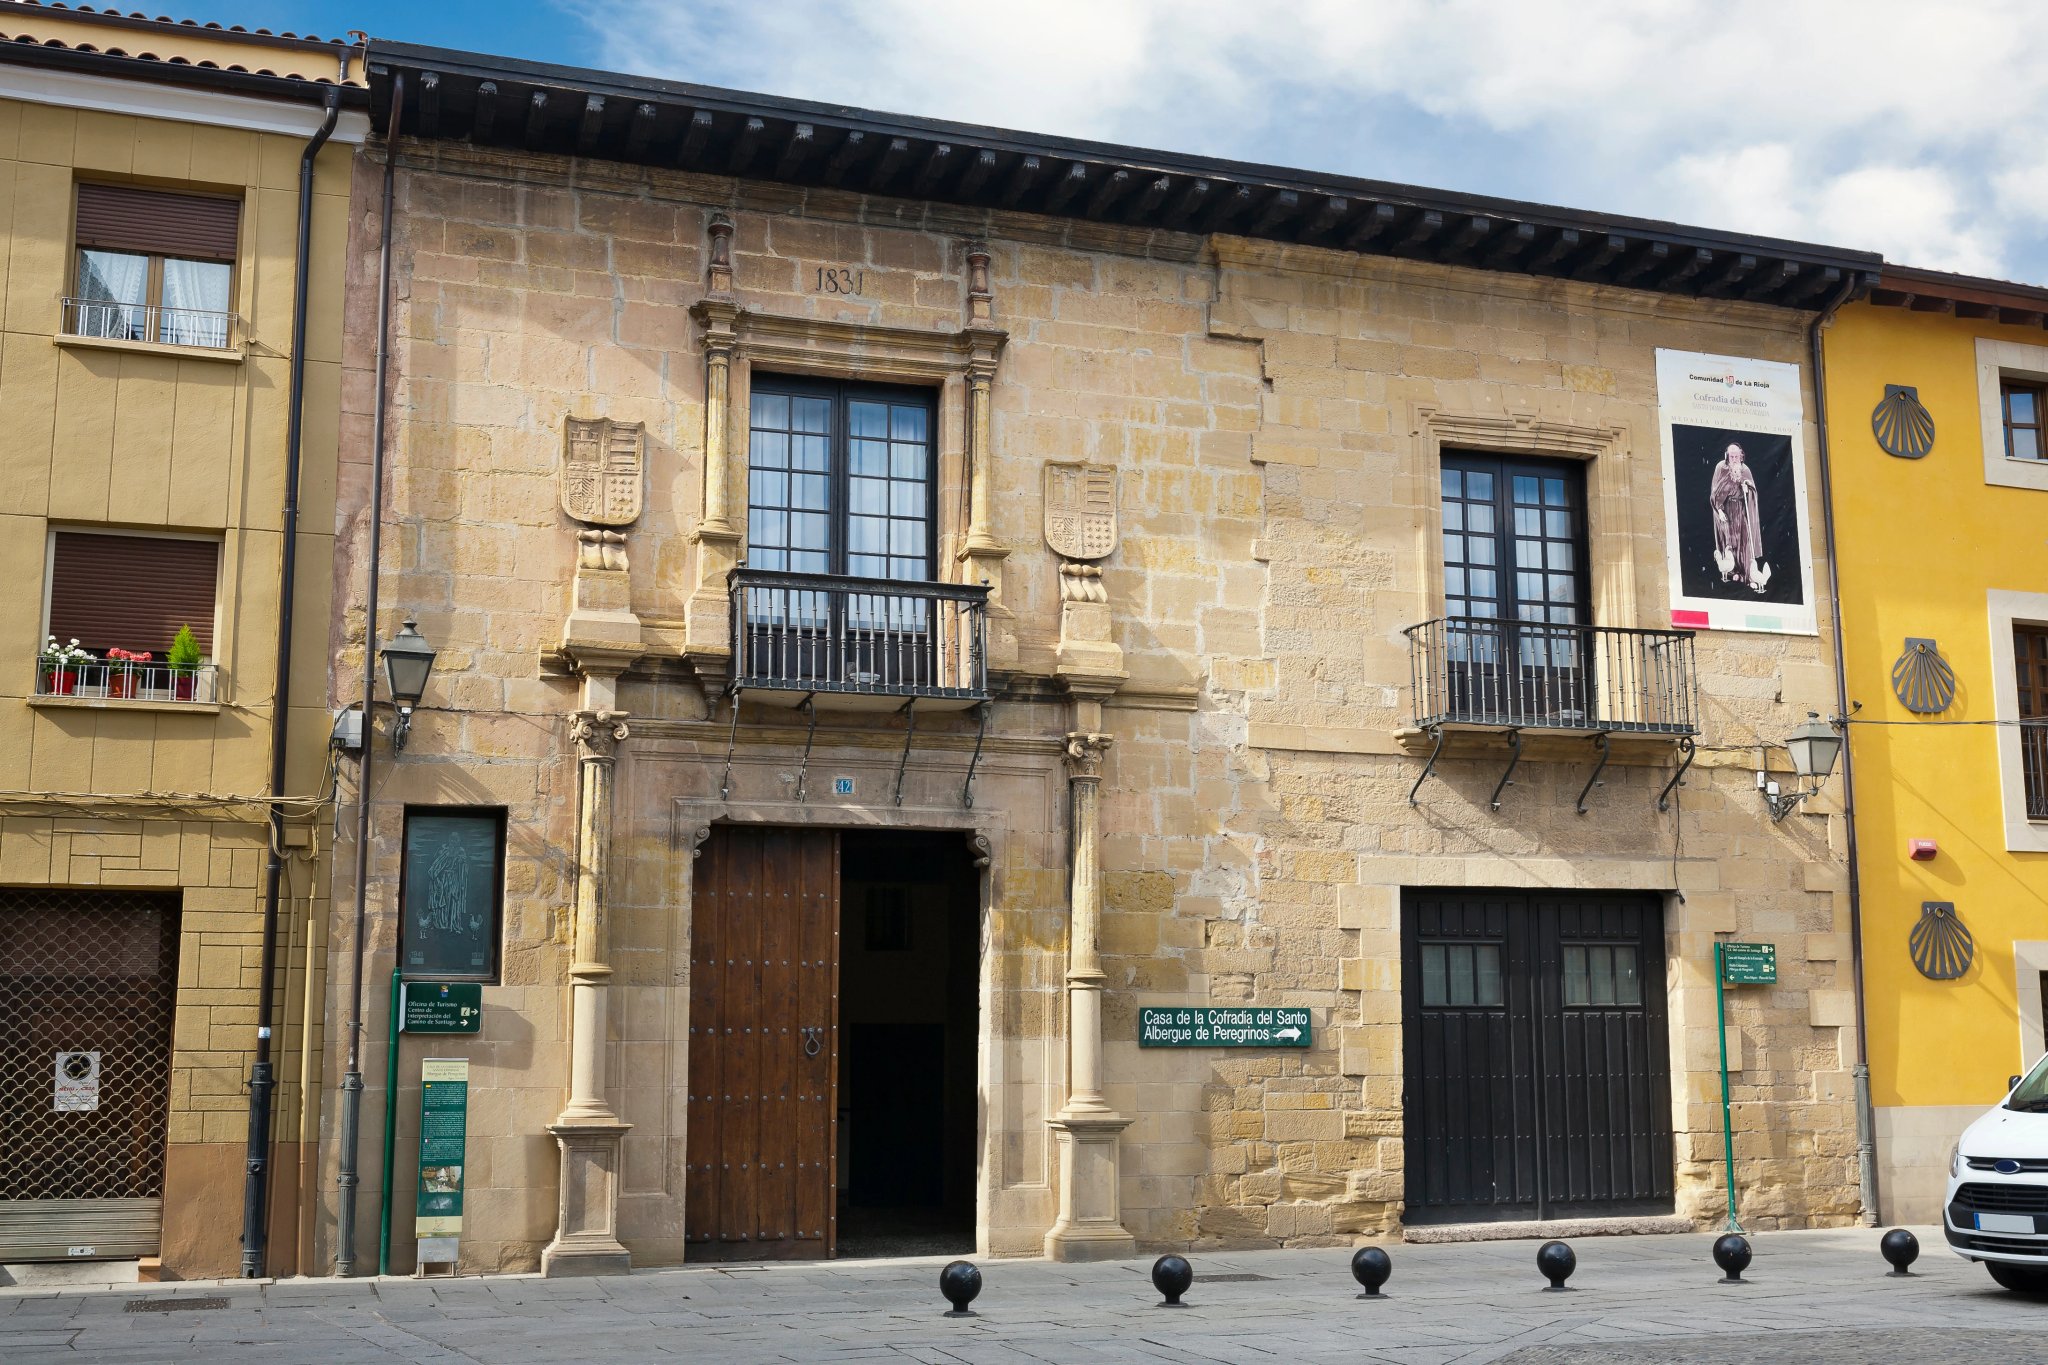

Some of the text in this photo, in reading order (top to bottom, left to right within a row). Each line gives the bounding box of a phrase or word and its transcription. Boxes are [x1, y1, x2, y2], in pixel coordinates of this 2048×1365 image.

[815, 266, 864, 296] 1831
[1689, 374, 1724, 384] Comunidad
[1730, 397, 1743, 406] del
[1745, 399, 1768, 409] Santo
[839, 780, 850, 793] 42
[1144, 1010, 1172, 1025] Casa
[1177, 1010, 1190, 1025] de
[1195, 1010, 1204, 1025] la
[1257, 1010, 1273, 1025] del
[1277, 1010, 1307, 1025] Santo
[1144, 1025, 1269, 1043] Albergue de Peregrinos
